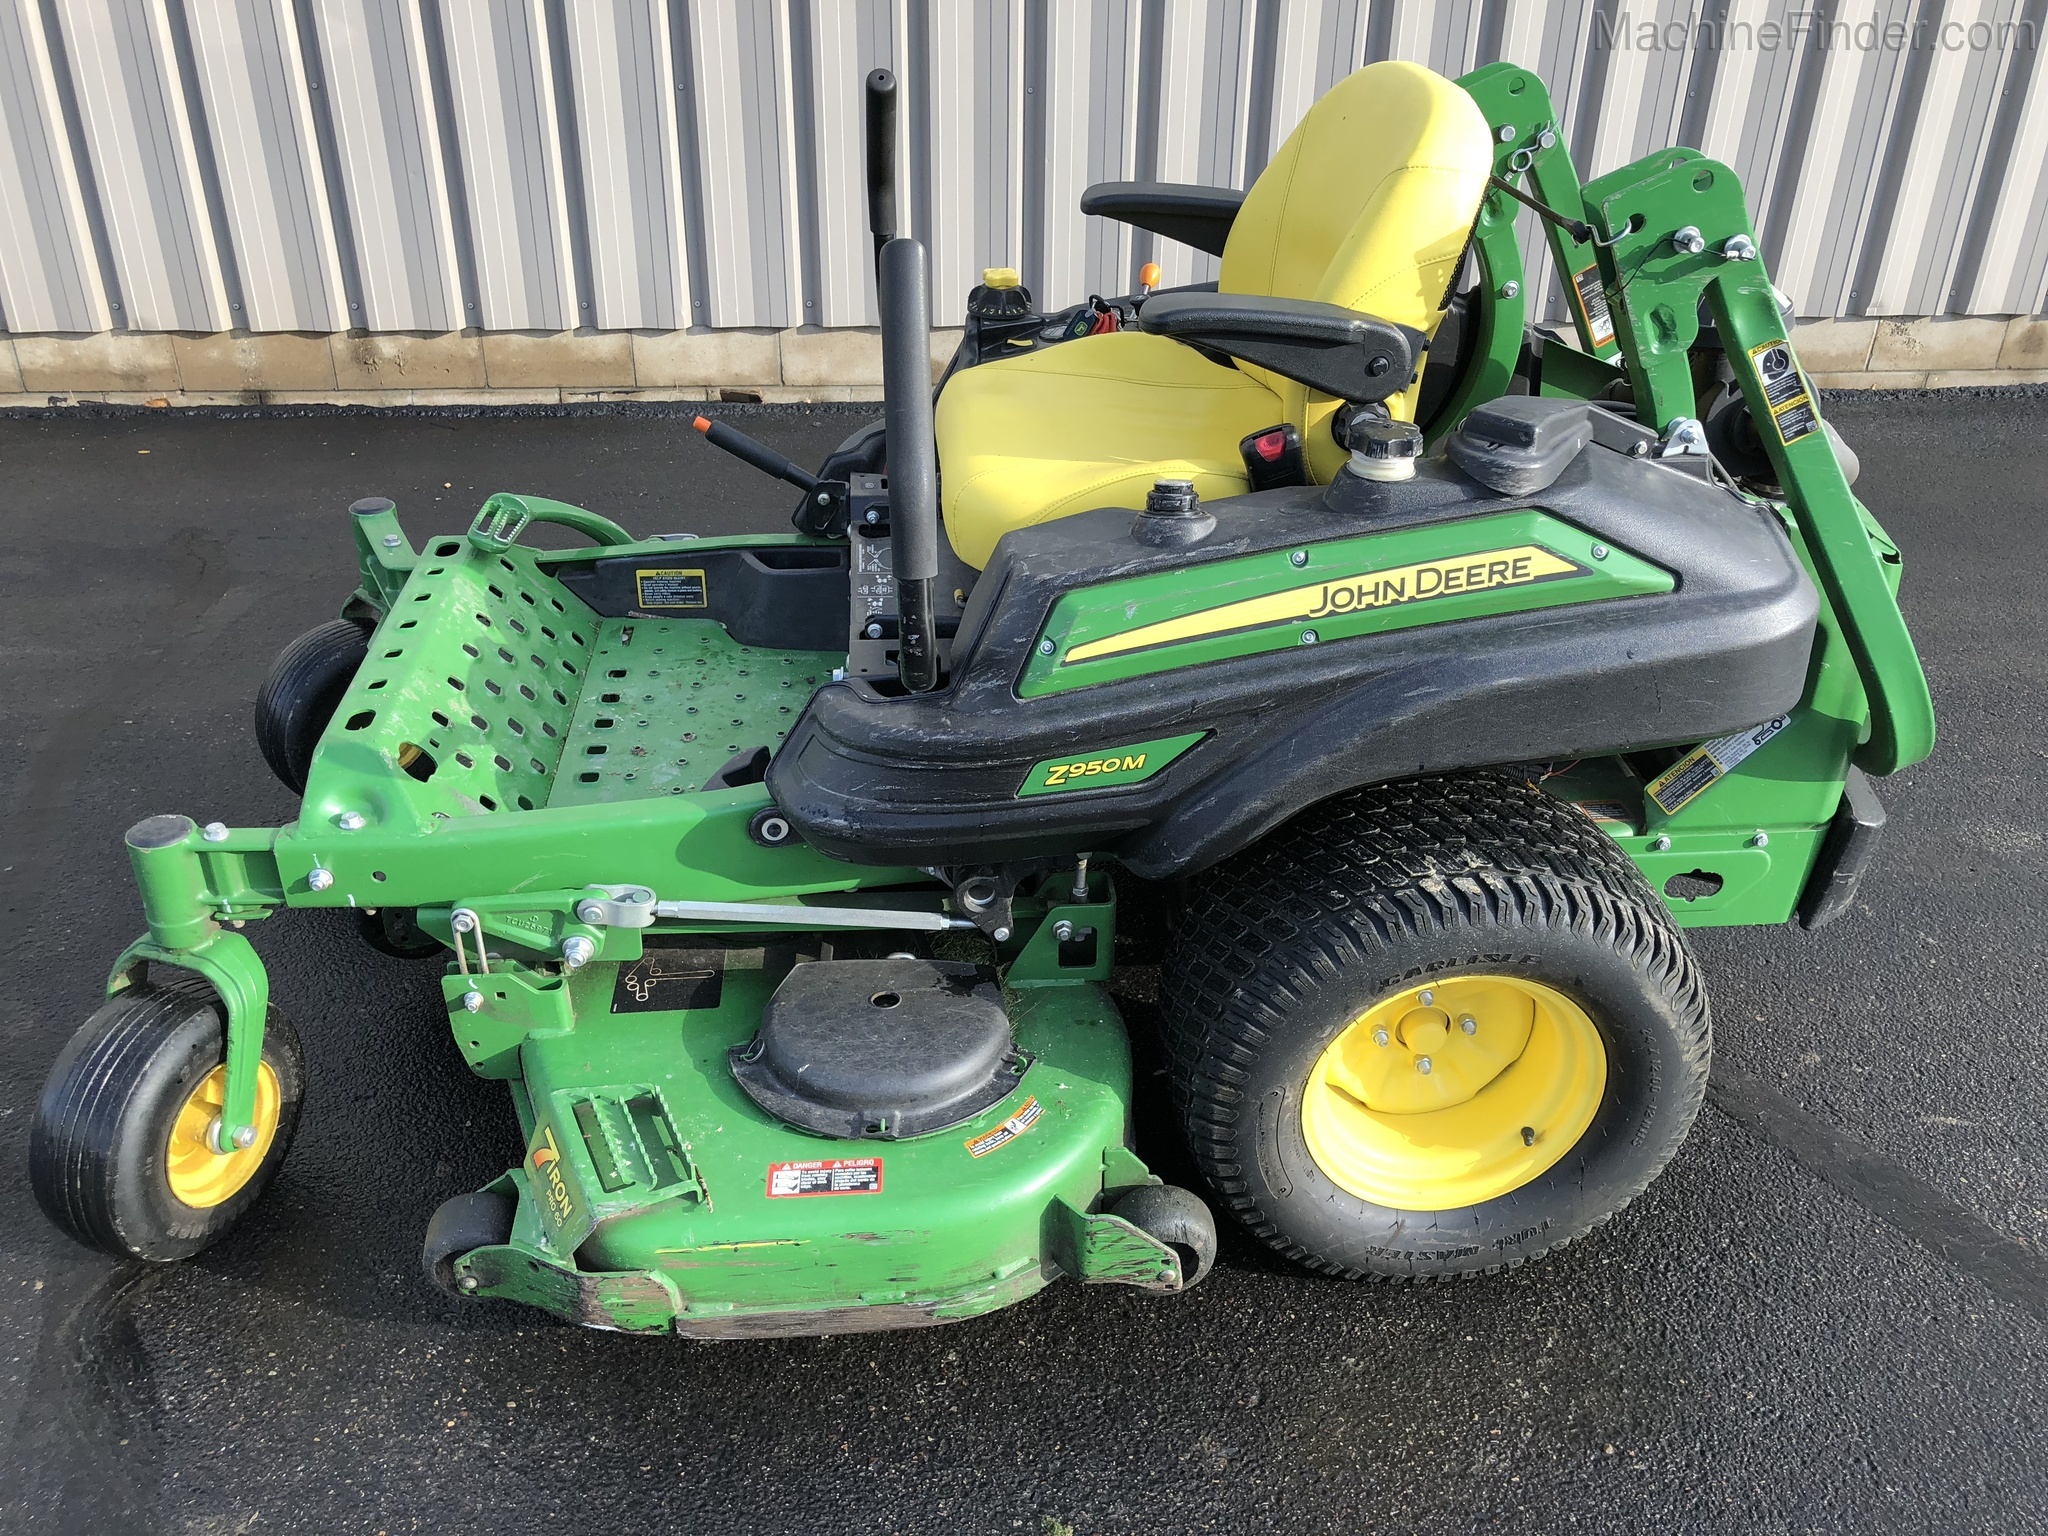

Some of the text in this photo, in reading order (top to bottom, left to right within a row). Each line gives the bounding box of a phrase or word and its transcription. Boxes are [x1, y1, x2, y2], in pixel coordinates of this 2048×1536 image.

[1309, 556, 1532, 615] JOHN DEERE
[1043, 753, 1148, 786] Z950M
[1377, 953, 1542, 993] CARLISLE
[792, 1161, 823, 1169] DANGER
[545, 1189, 557, 1212] PRO
[1365, 1244, 1481, 1261] MASTER
